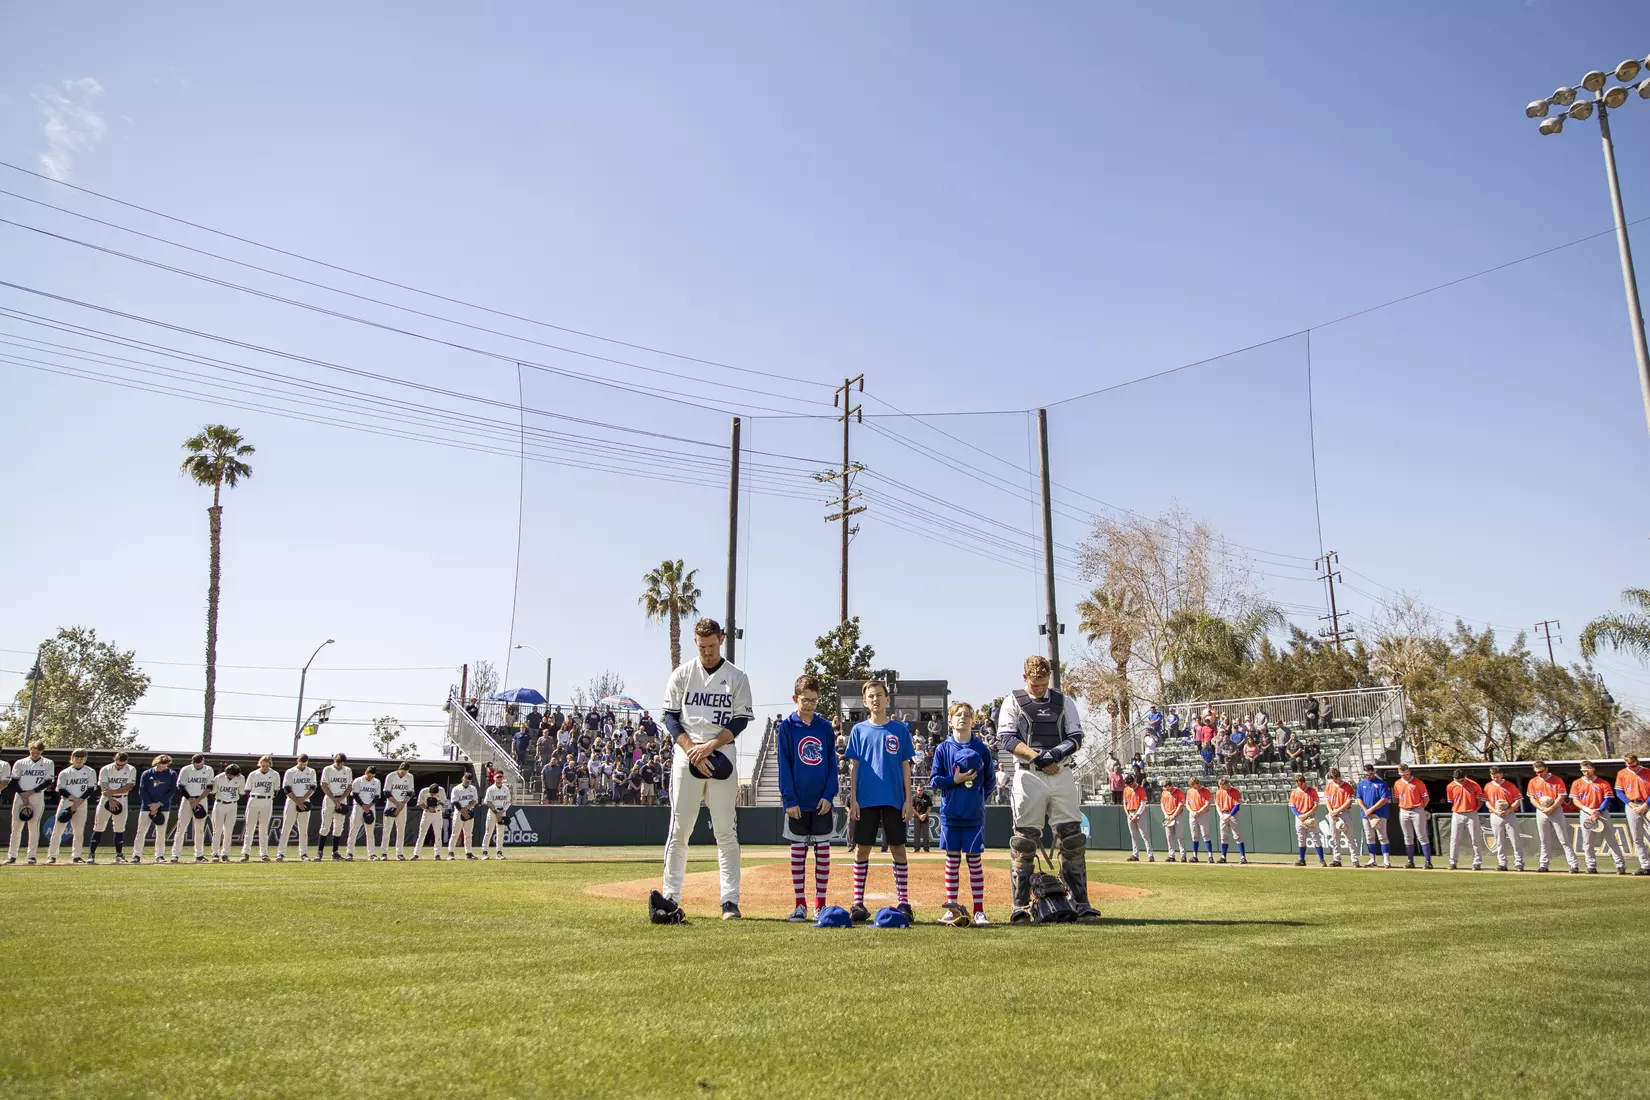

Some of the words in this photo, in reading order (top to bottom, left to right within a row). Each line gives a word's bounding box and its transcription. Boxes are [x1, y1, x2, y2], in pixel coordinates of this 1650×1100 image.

[684, 691, 732, 708] LANCERS
[711, 710, 731, 726] 36
[66, 777, 89, 786] LANCERS
